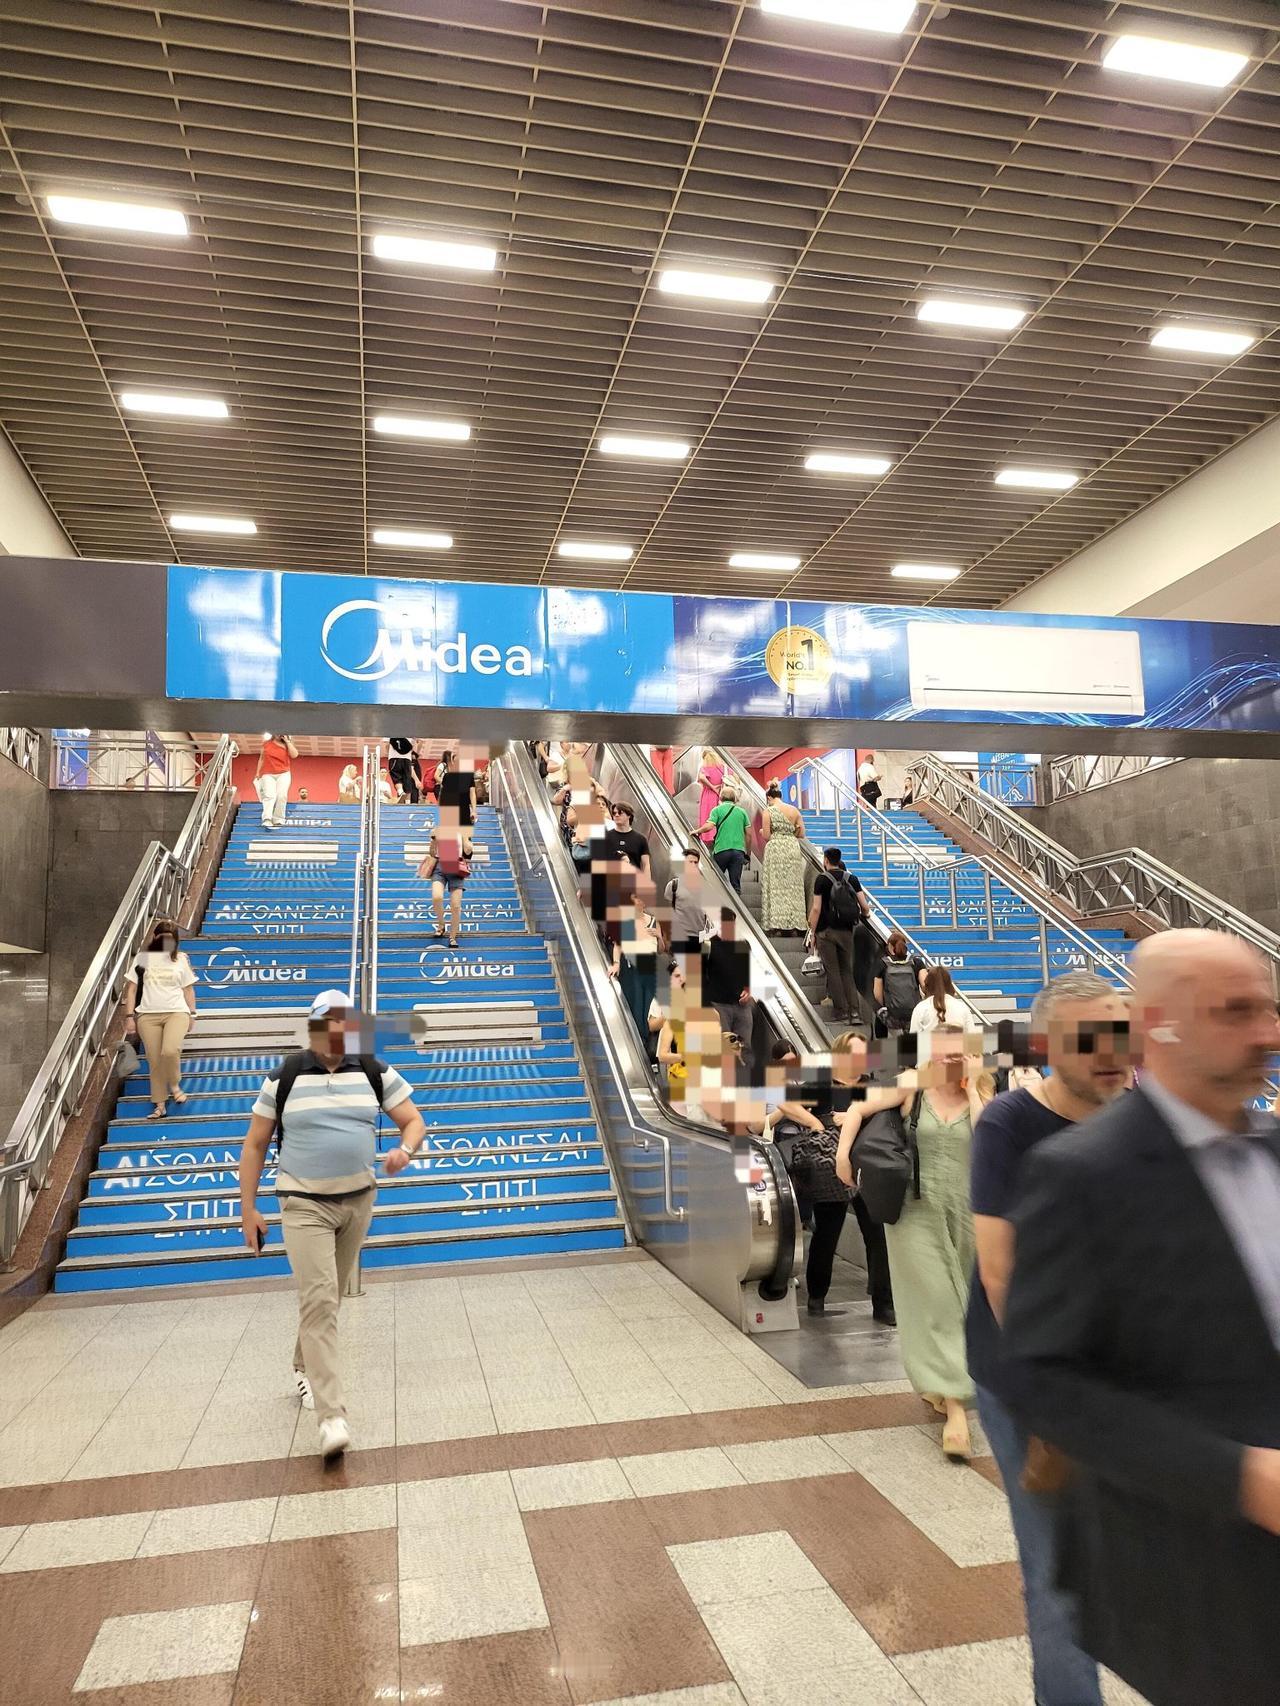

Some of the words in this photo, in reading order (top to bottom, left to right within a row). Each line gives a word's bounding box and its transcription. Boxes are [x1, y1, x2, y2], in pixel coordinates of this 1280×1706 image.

[345, 624, 532, 678] Midea
[801, 639, 814, 670] 1
[215, 956, 307, 983] Midea
[430, 954, 515, 980] Midea
